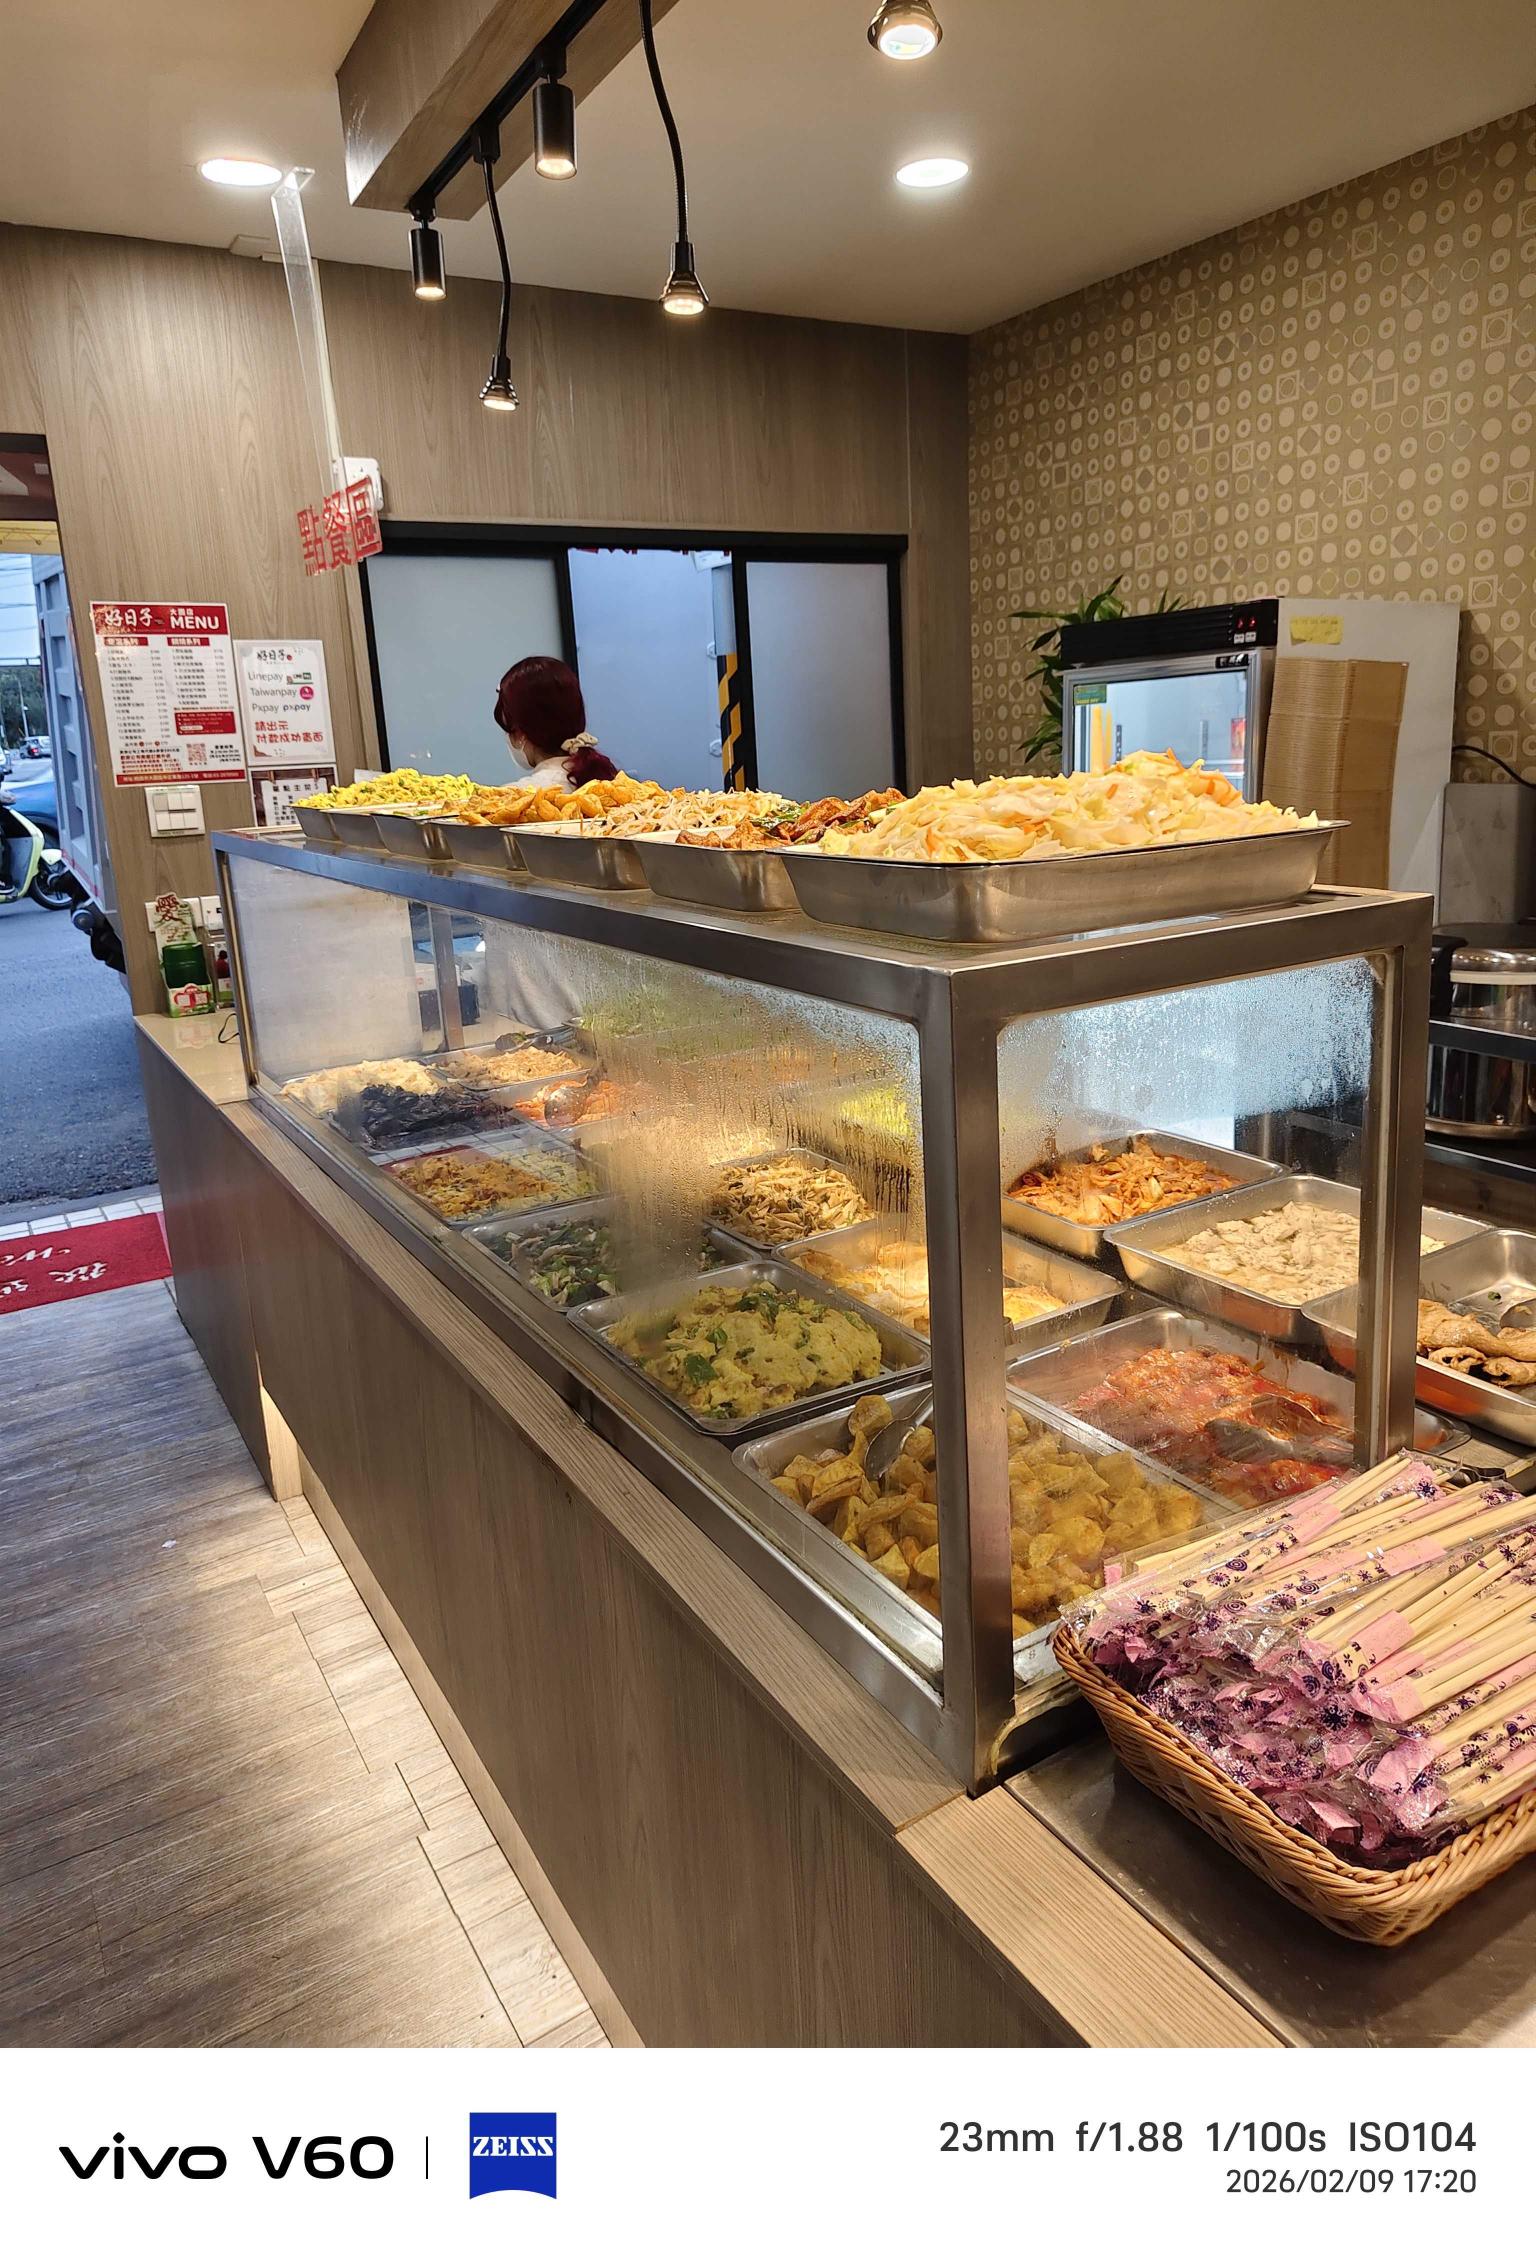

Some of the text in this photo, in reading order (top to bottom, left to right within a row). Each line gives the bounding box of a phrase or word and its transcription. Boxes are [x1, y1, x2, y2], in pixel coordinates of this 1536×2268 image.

[297, 475, 384, 576] 點餐區
[104, 608, 153, 627] 好日子
[170, 615, 220, 630] MENU
[256, 649, 285, 661] 好日子
[248, 671, 284, 683] Linepay
[250, 687, 297, 698] Taiwanpay
[252, 703, 280, 714] Pxpay
[255, 720, 289, 732] 請出示
[256, 731, 324, 744] 付款成功畫面
